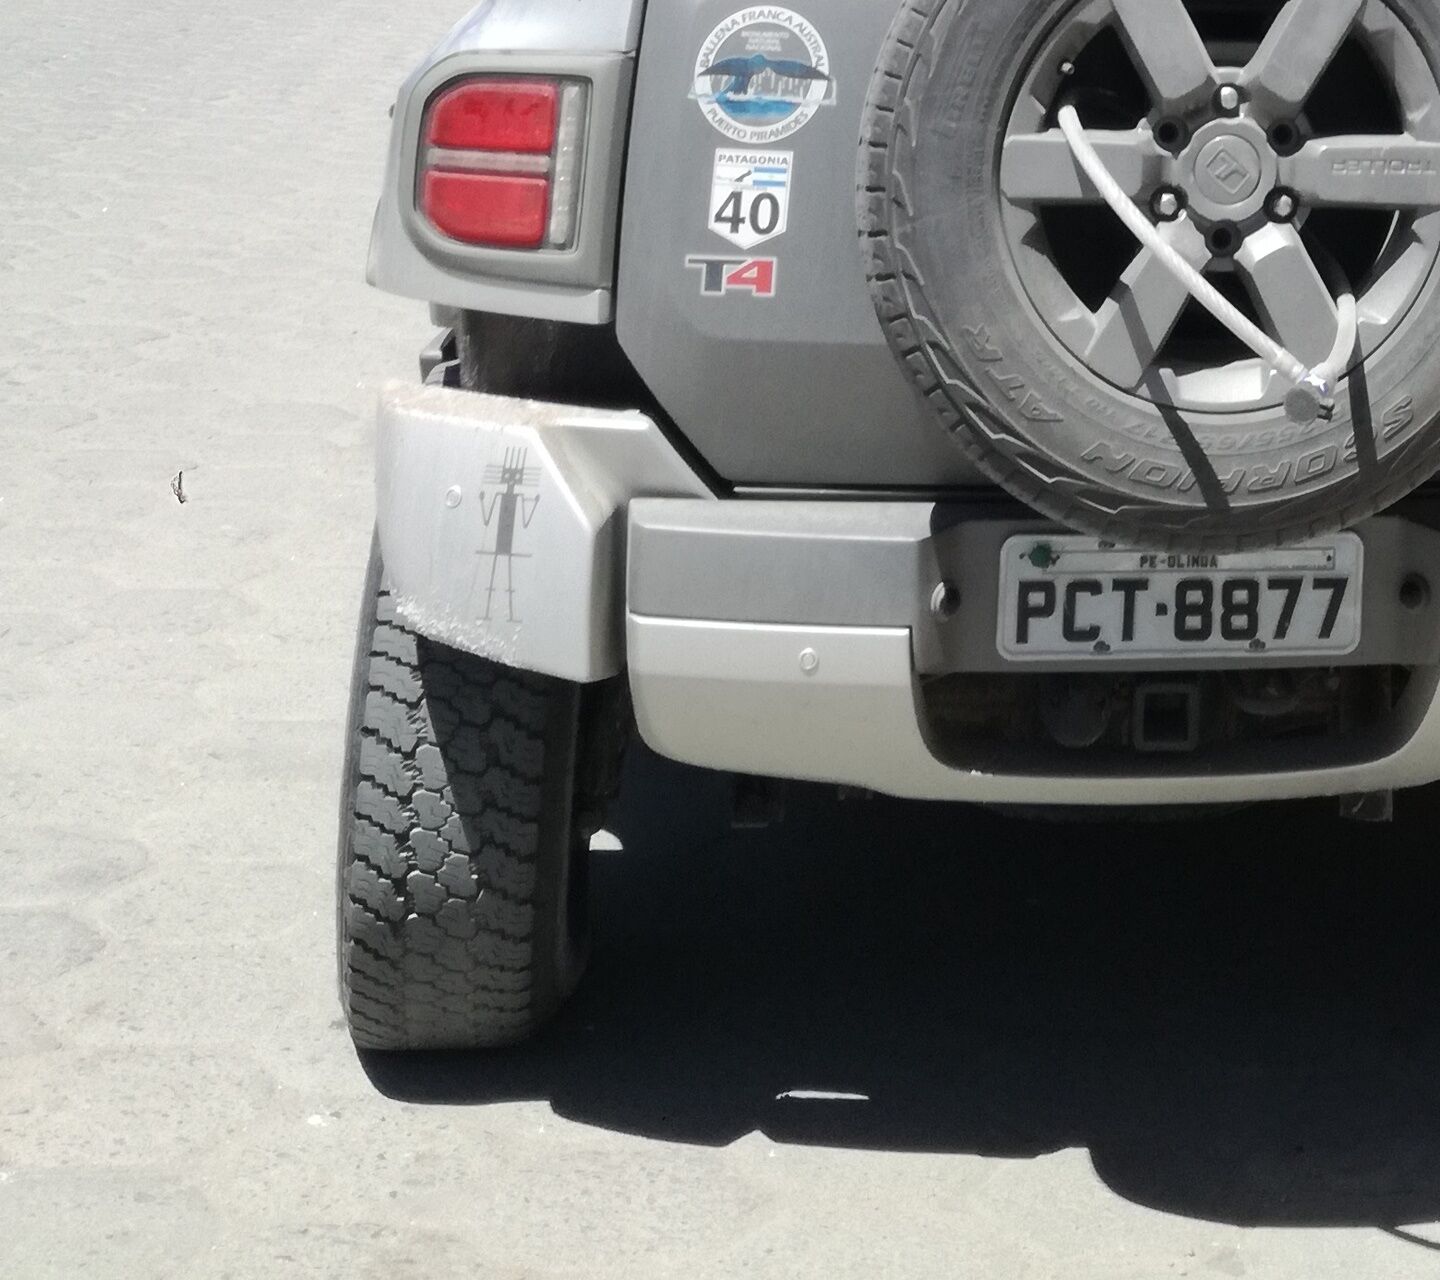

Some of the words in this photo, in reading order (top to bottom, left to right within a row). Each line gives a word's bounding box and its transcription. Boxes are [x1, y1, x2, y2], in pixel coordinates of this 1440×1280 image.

[700, 18, 741, 68] BALLENA
[741, 9, 794, 26] FRANCA
[794, 22, 826, 69] AUSTRAL
[707, 107, 748, 139] PUERTO
[750, 110, 809, 141] PIRAMIDES
[718, 154, 789, 166] PATAGONIA
[714, 191, 780, 235] 40
[685, 254, 777, 297] T4
